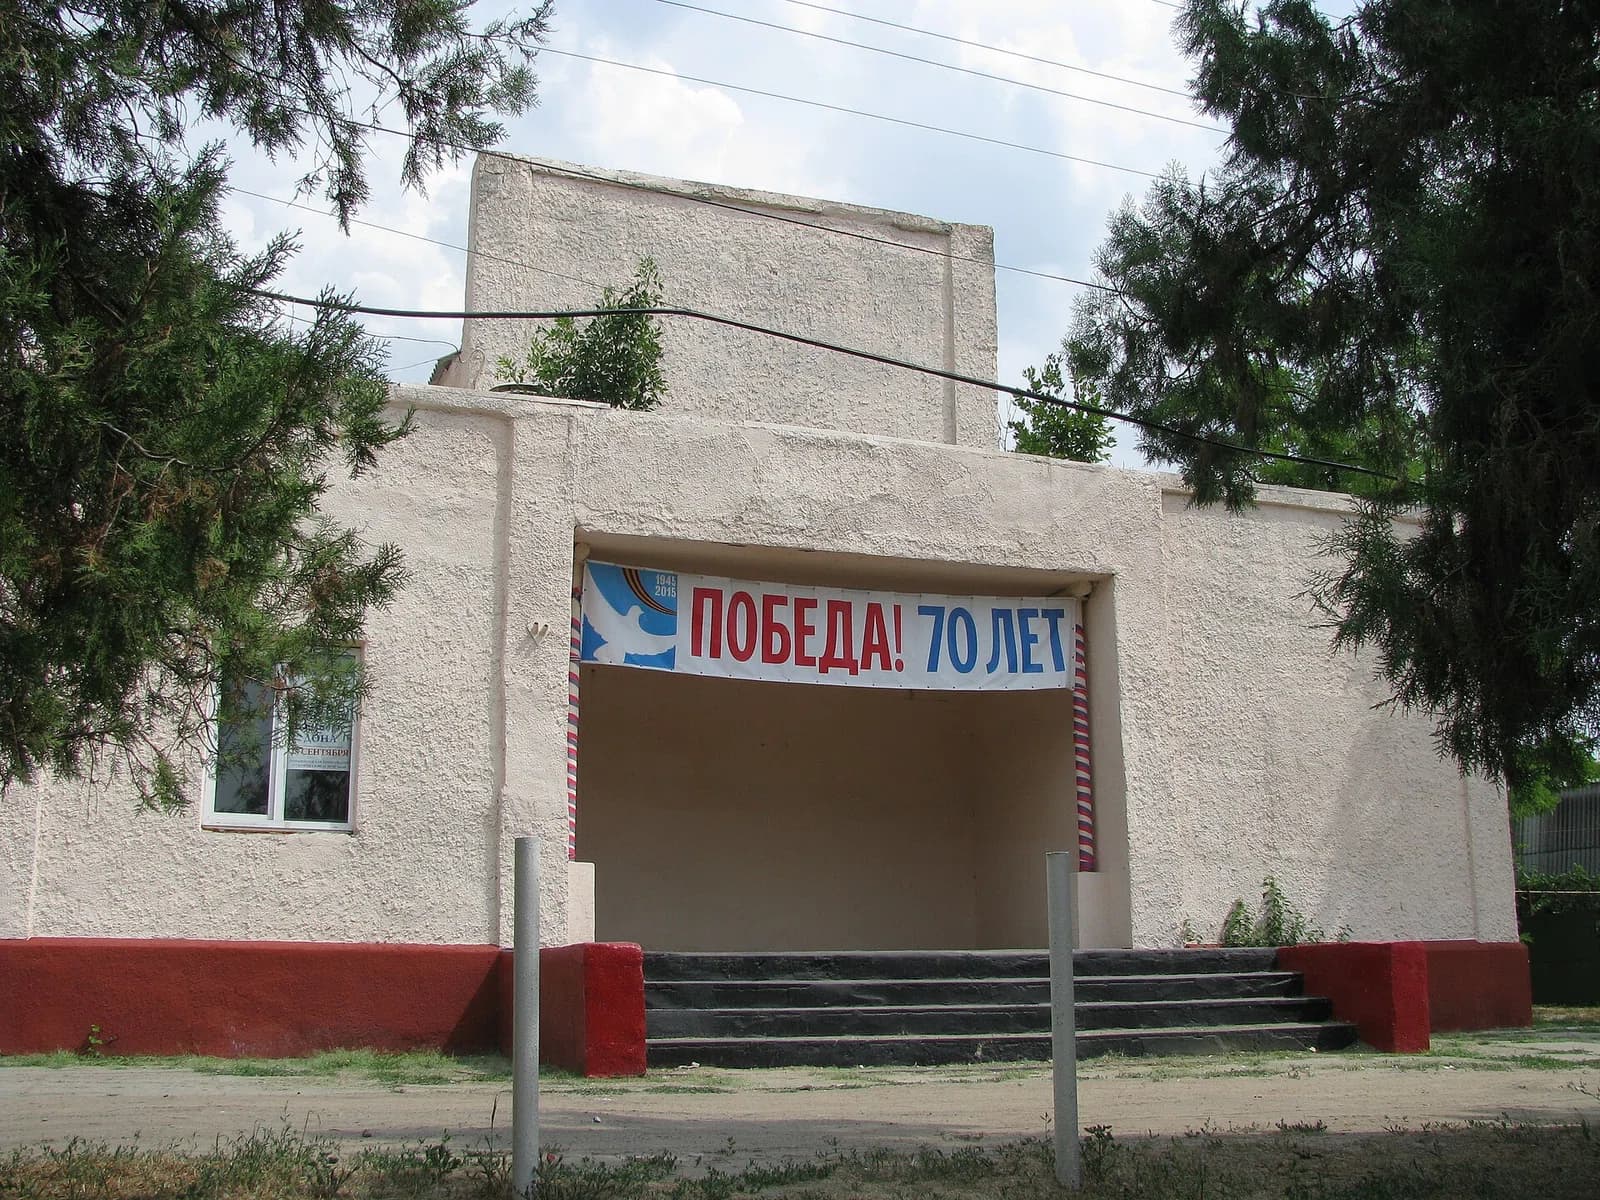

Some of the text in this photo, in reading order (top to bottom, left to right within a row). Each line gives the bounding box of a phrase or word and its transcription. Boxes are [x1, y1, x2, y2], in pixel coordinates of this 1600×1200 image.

[655, 573, 676, 586] 1945
[655, 585, 677, 598] 2015
[691, 587, 1066, 676] ПОБЕДА! 70 ЛЕТ
